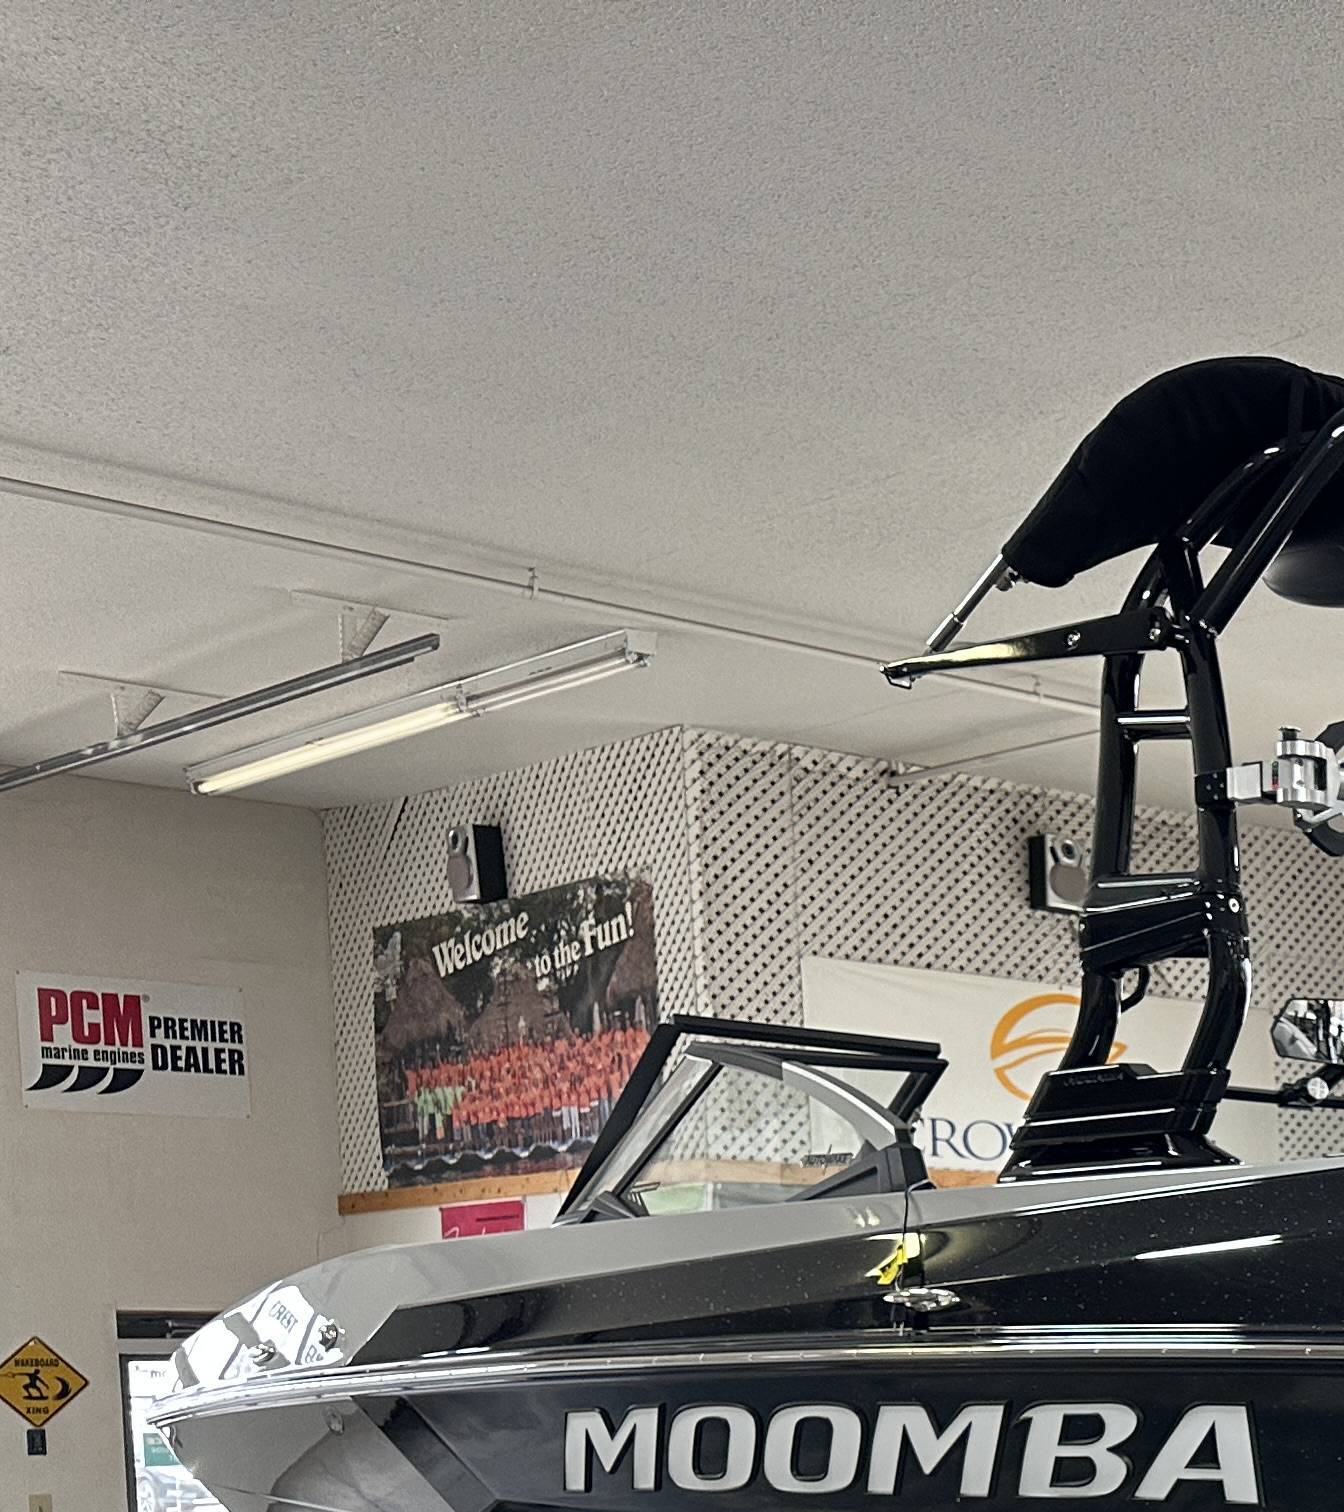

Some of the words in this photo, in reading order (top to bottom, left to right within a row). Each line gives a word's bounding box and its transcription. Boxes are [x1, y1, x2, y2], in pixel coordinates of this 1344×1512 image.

[432, 911, 529, 978] Welcome
[534, 952, 550, 978] to
[552, 939, 582, 969] the
[580, 901, 635, 957] Fun!
[37, 987, 144, 1048] PCM
[148, 1015, 243, 1044] PREMIER
[41, 1045, 89, 1062] marine
[93, 1047, 145, 1066] engines
[150, 1043, 245, 1076] DEALER
[269, 1300, 298, 1334] CREST
[14, 1357, 60, 1368] WAKEBOARD
[26, 1405, 50, 1415] XING
[562, 1402, 1264, 1506] MOOMBA
